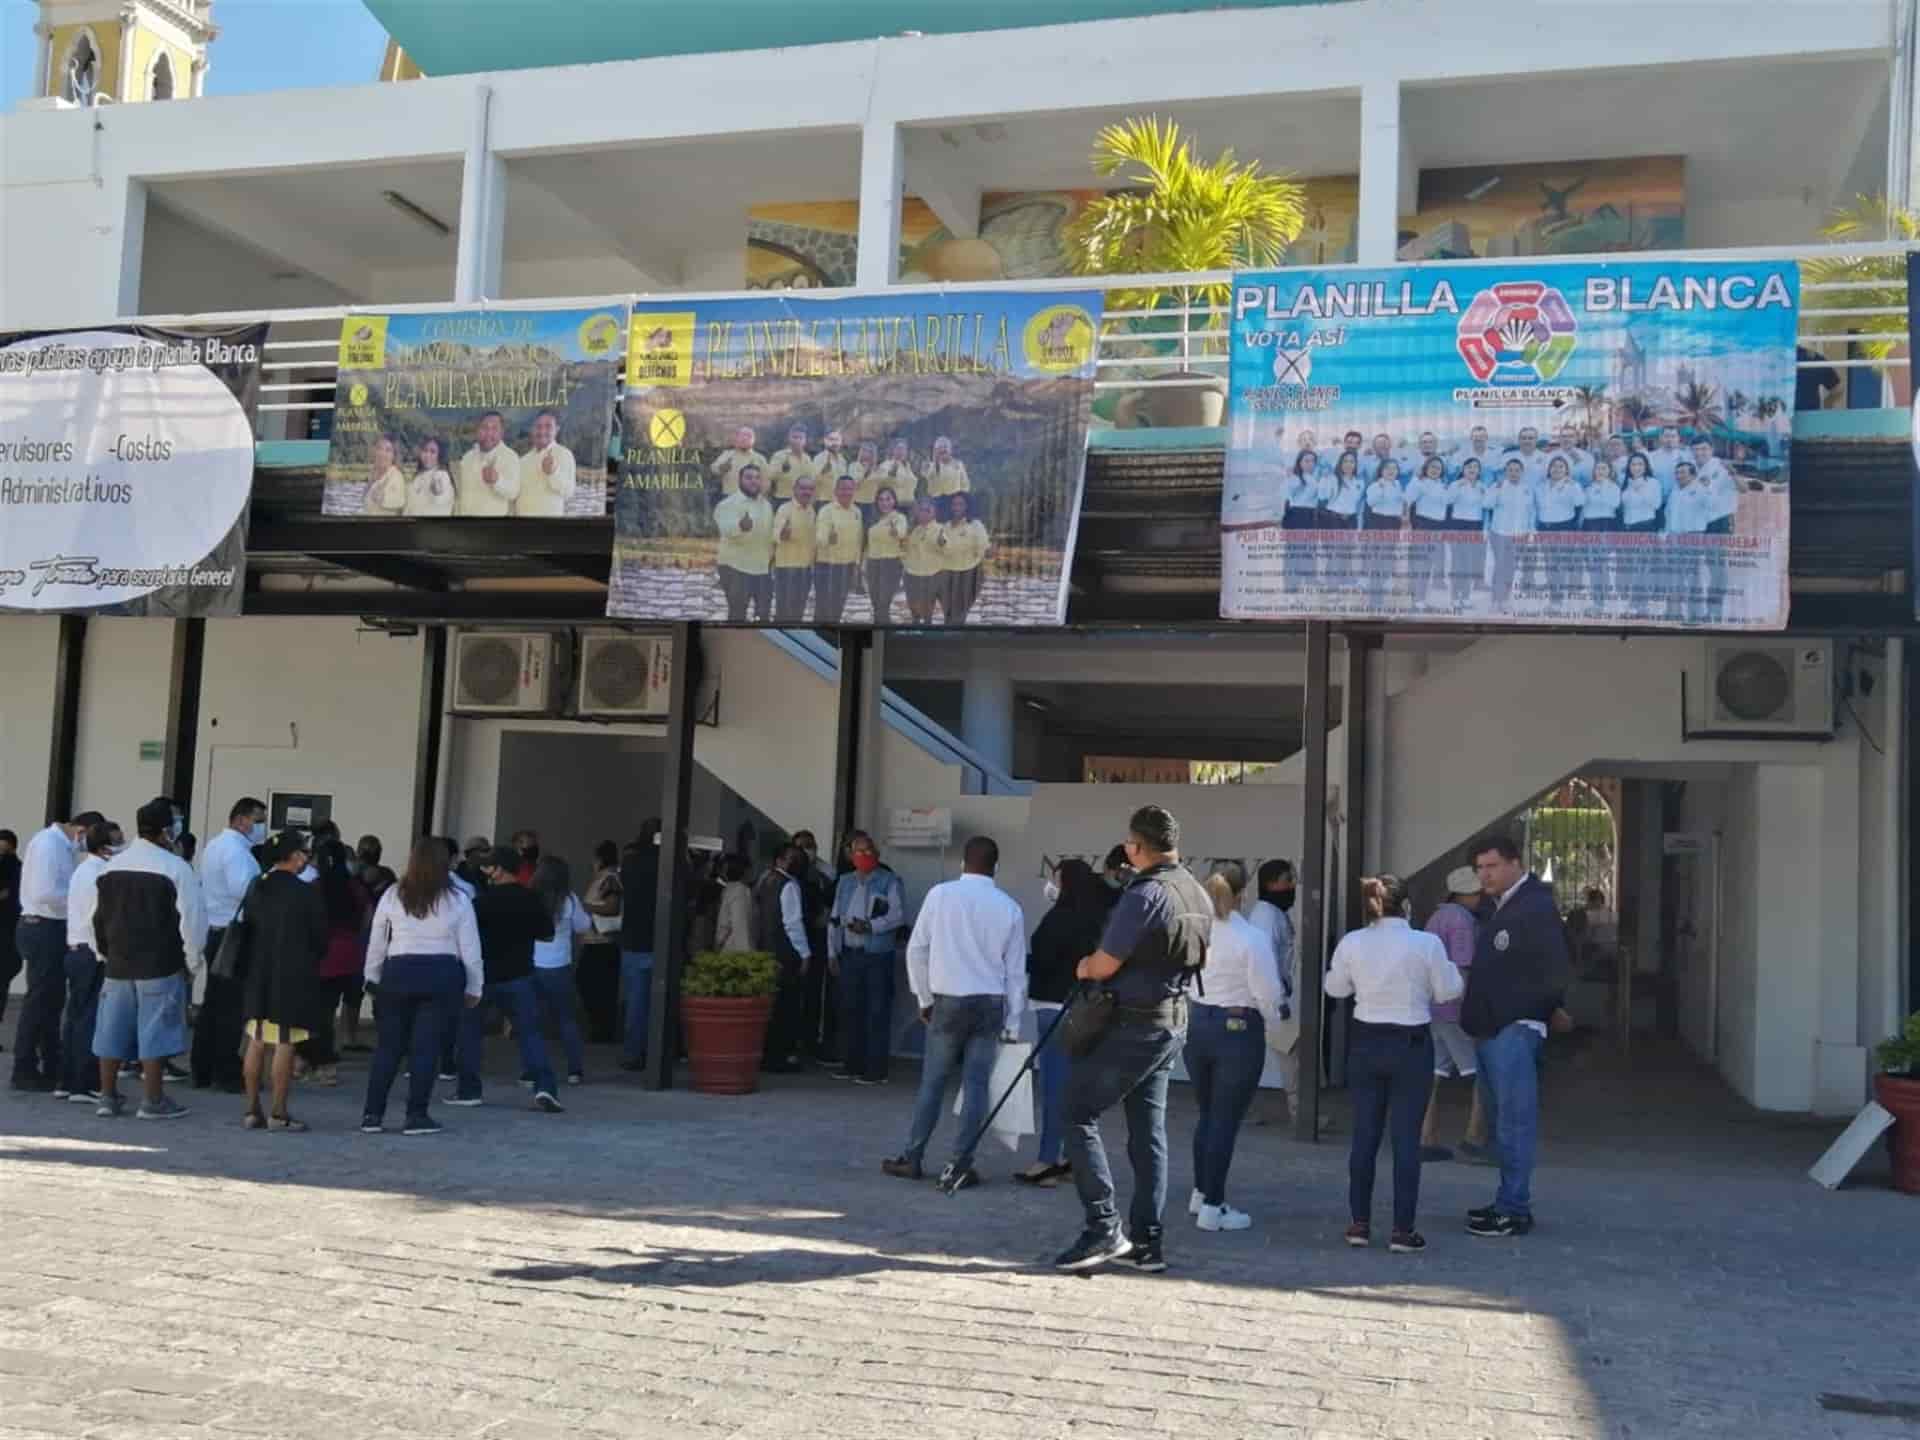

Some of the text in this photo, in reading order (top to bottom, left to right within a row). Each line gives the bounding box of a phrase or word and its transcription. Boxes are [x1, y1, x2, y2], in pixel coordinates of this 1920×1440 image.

[1236, 280, 1459, 320] PLANILLA
[1585, 274, 1793, 312] BLANCA
[204, 337, 259, 364] Blanca.
[704, 311, 1013, 379] PLANILLA AMARILLA
[1245, 330, 1299, 347] VOTA
[627, 448, 701, 465] PLANILLA
[1, 475, 133, 505] Administrativos
[623, 472, 705, 489] AMARILLA
